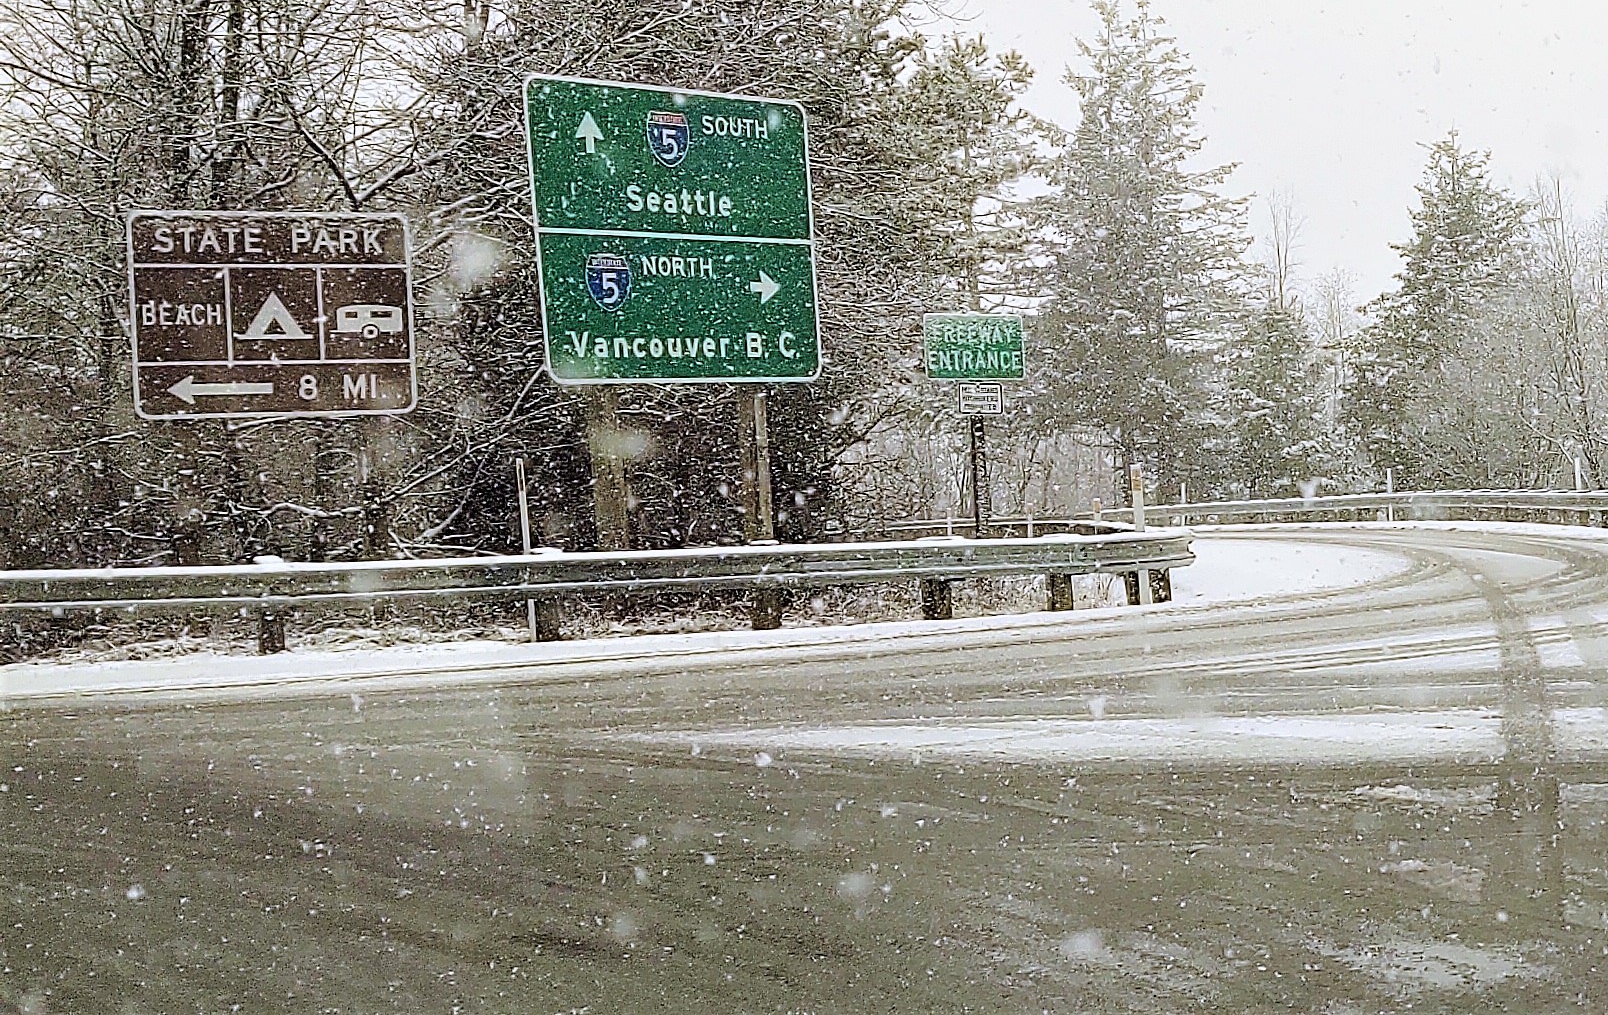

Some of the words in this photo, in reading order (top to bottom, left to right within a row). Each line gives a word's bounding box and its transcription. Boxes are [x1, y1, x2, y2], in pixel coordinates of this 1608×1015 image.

[661, 128, 679, 160] 5
[701, 115, 768, 140] SOUTH
[626, 185, 733, 217] Seattle
[151, 225, 262, 254] STATE
[291, 227, 383, 255] PARK
[602, 272, 619, 304] 5
[641, 255, 713, 278] NORTH
[141, 303, 222, 326] BEACH
[565, 330, 730, 359] Vancouver
[927, 350, 1023, 371] ENTRANCE
[298, 374, 318, 401] 8
[343, 373, 377, 399] MI
